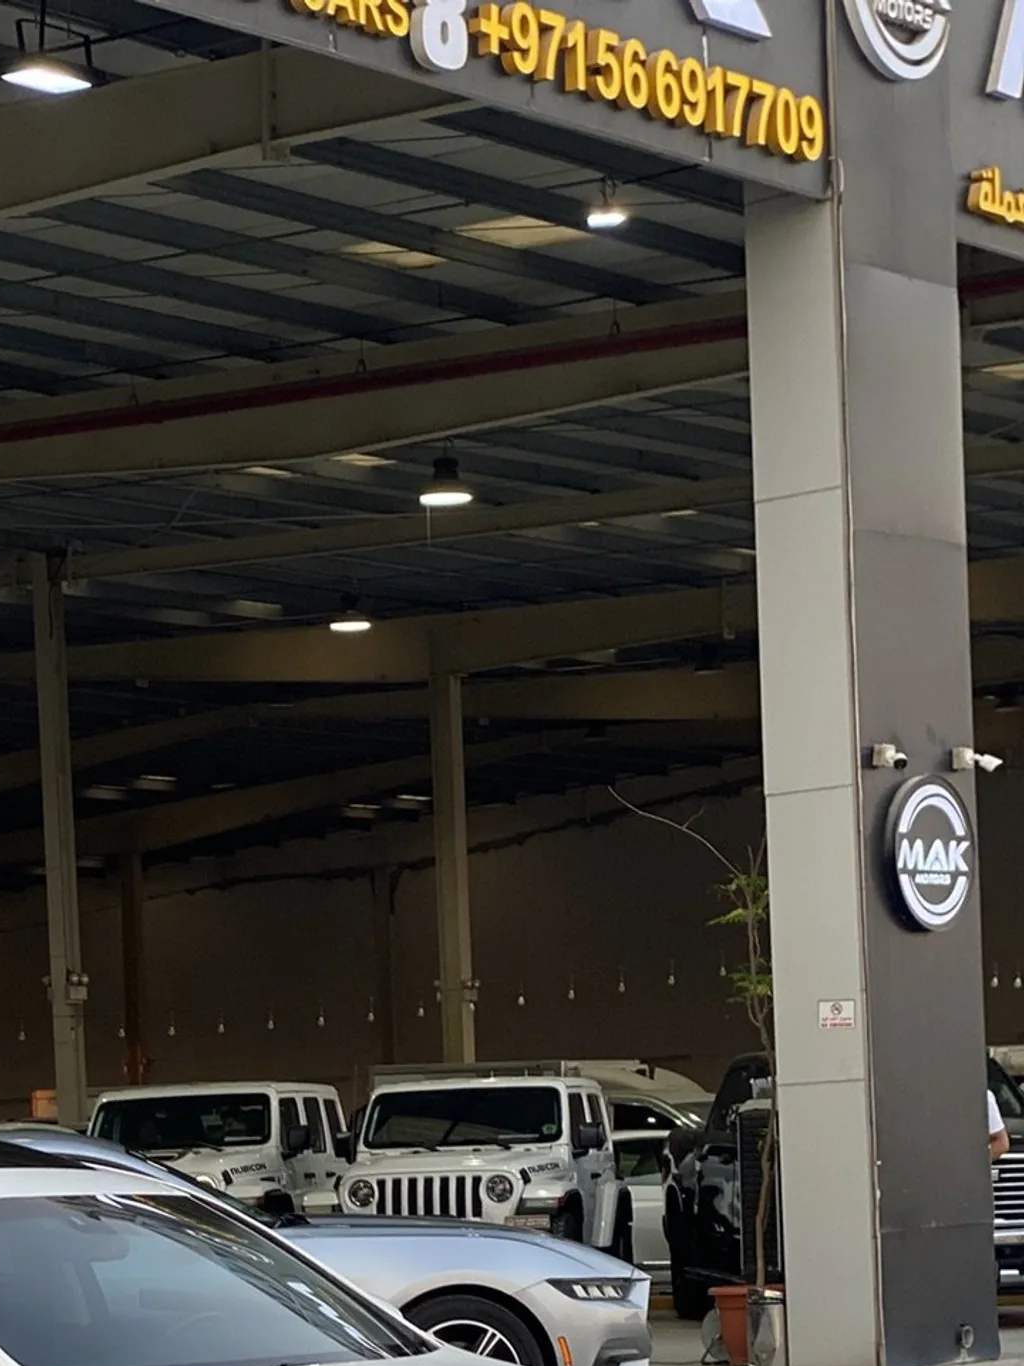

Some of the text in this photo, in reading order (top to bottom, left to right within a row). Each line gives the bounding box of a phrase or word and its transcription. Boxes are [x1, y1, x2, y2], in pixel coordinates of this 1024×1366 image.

[298, 0, 410, 37] RS
[897, 838, 970, 871] MAK
[230, 1162, 268, 1175] RUBICON
[527, 1162, 560, 1174] RUBICON
